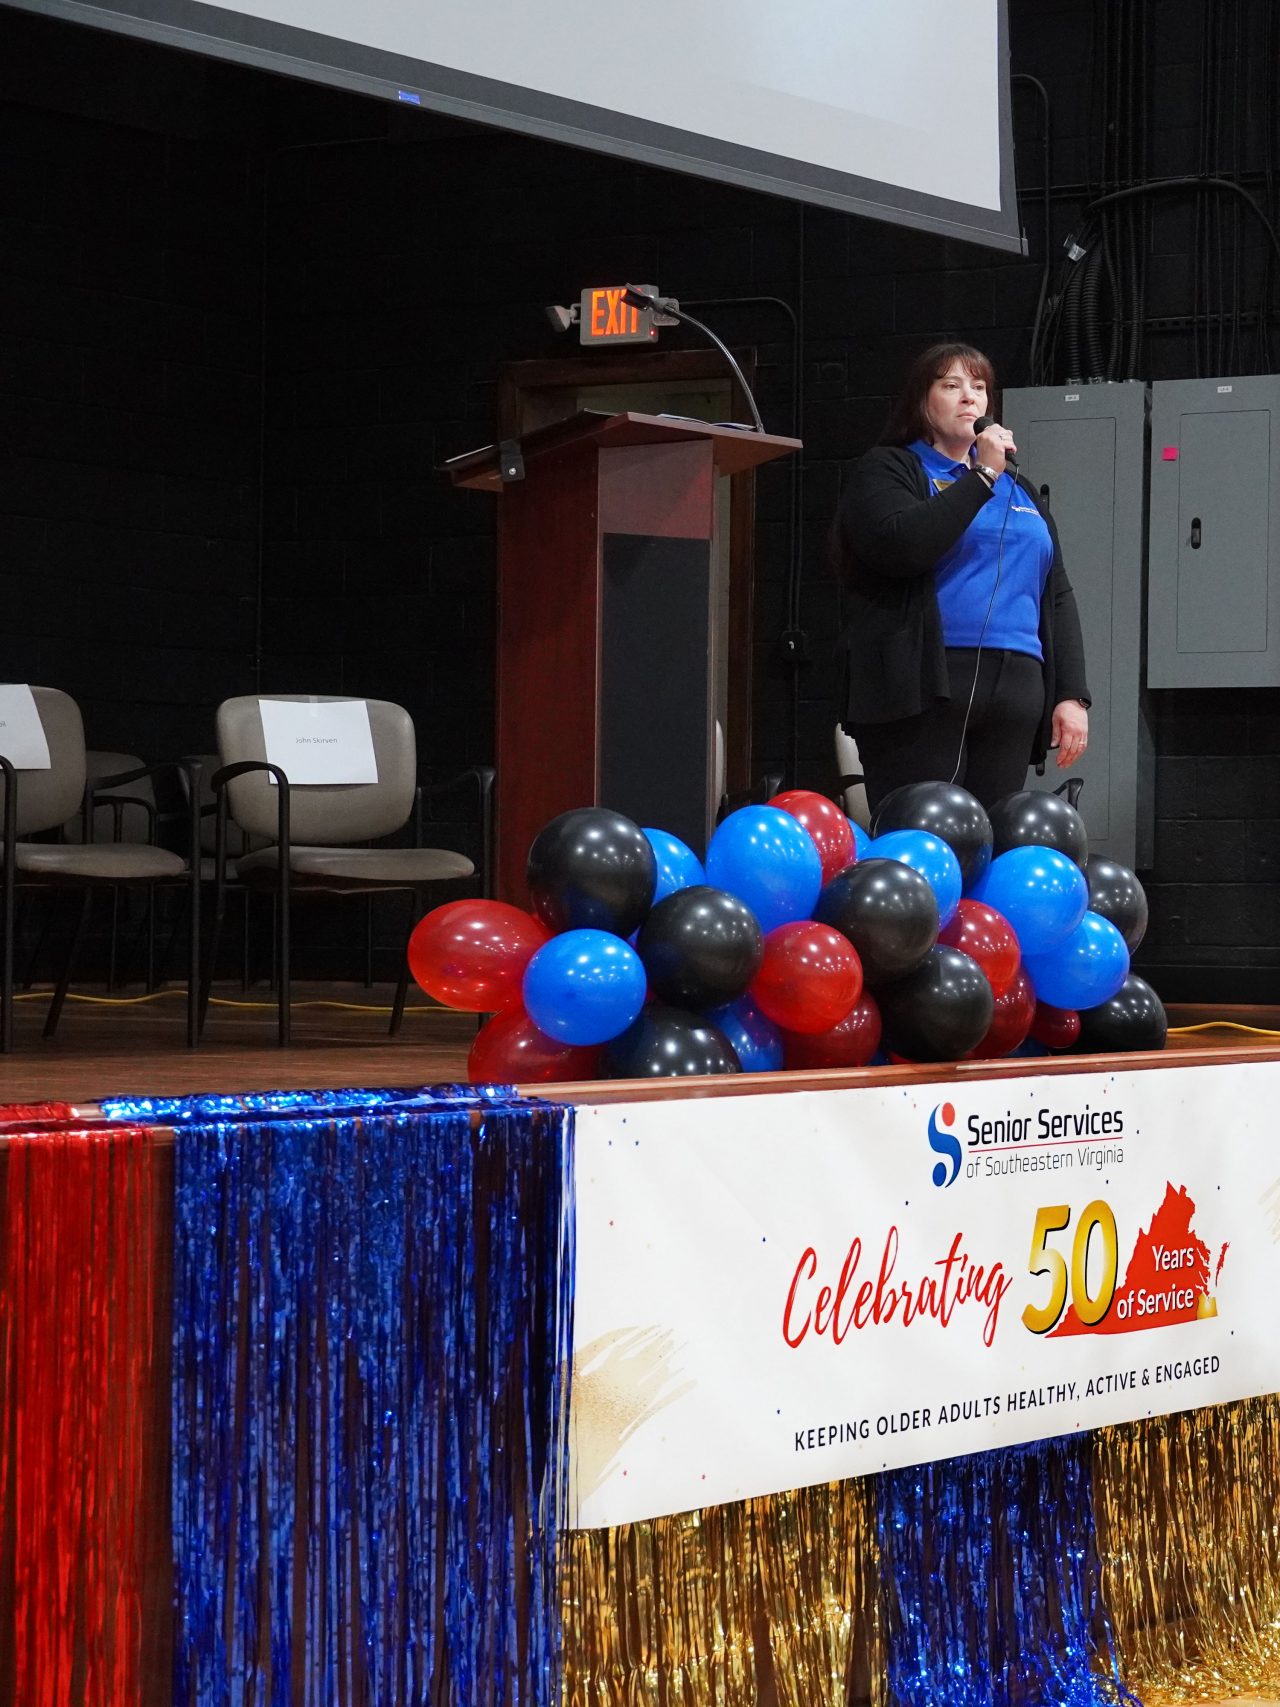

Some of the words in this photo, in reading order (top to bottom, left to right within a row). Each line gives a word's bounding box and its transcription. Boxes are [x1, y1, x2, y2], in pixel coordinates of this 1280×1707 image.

[967, 1111, 1032, 1146] Senior
[1037, 1104, 1124, 1139] Services
[966, 1156, 981, 1178] of
[985, 1152, 1073, 1177] Southeastern
[1077, 1145, 1125, 1171] Virginia
[782, 1226, 1013, 1348] Celebrating
[1021, 1199, 1119, 1335] 50
[1151, 1244, 1195, 1274] Years
[1116, 1297, 1135, 1321] of
[1136, 1287, 1195, 1316] Service
[794, 1420, 870, 1452] KEEPING
[876, 1409, 931, 1435] OLDER
[938, 1396, 1001, 1424] ADULTS
[1006, 1381, 1082, 1413] HEALTHY,
[1085, 1371, 1138, 1398] ACTIVE
[1141, 1368, 1151, 1387] &
[1156, 1355, 1221, 1383] ENGAGED
